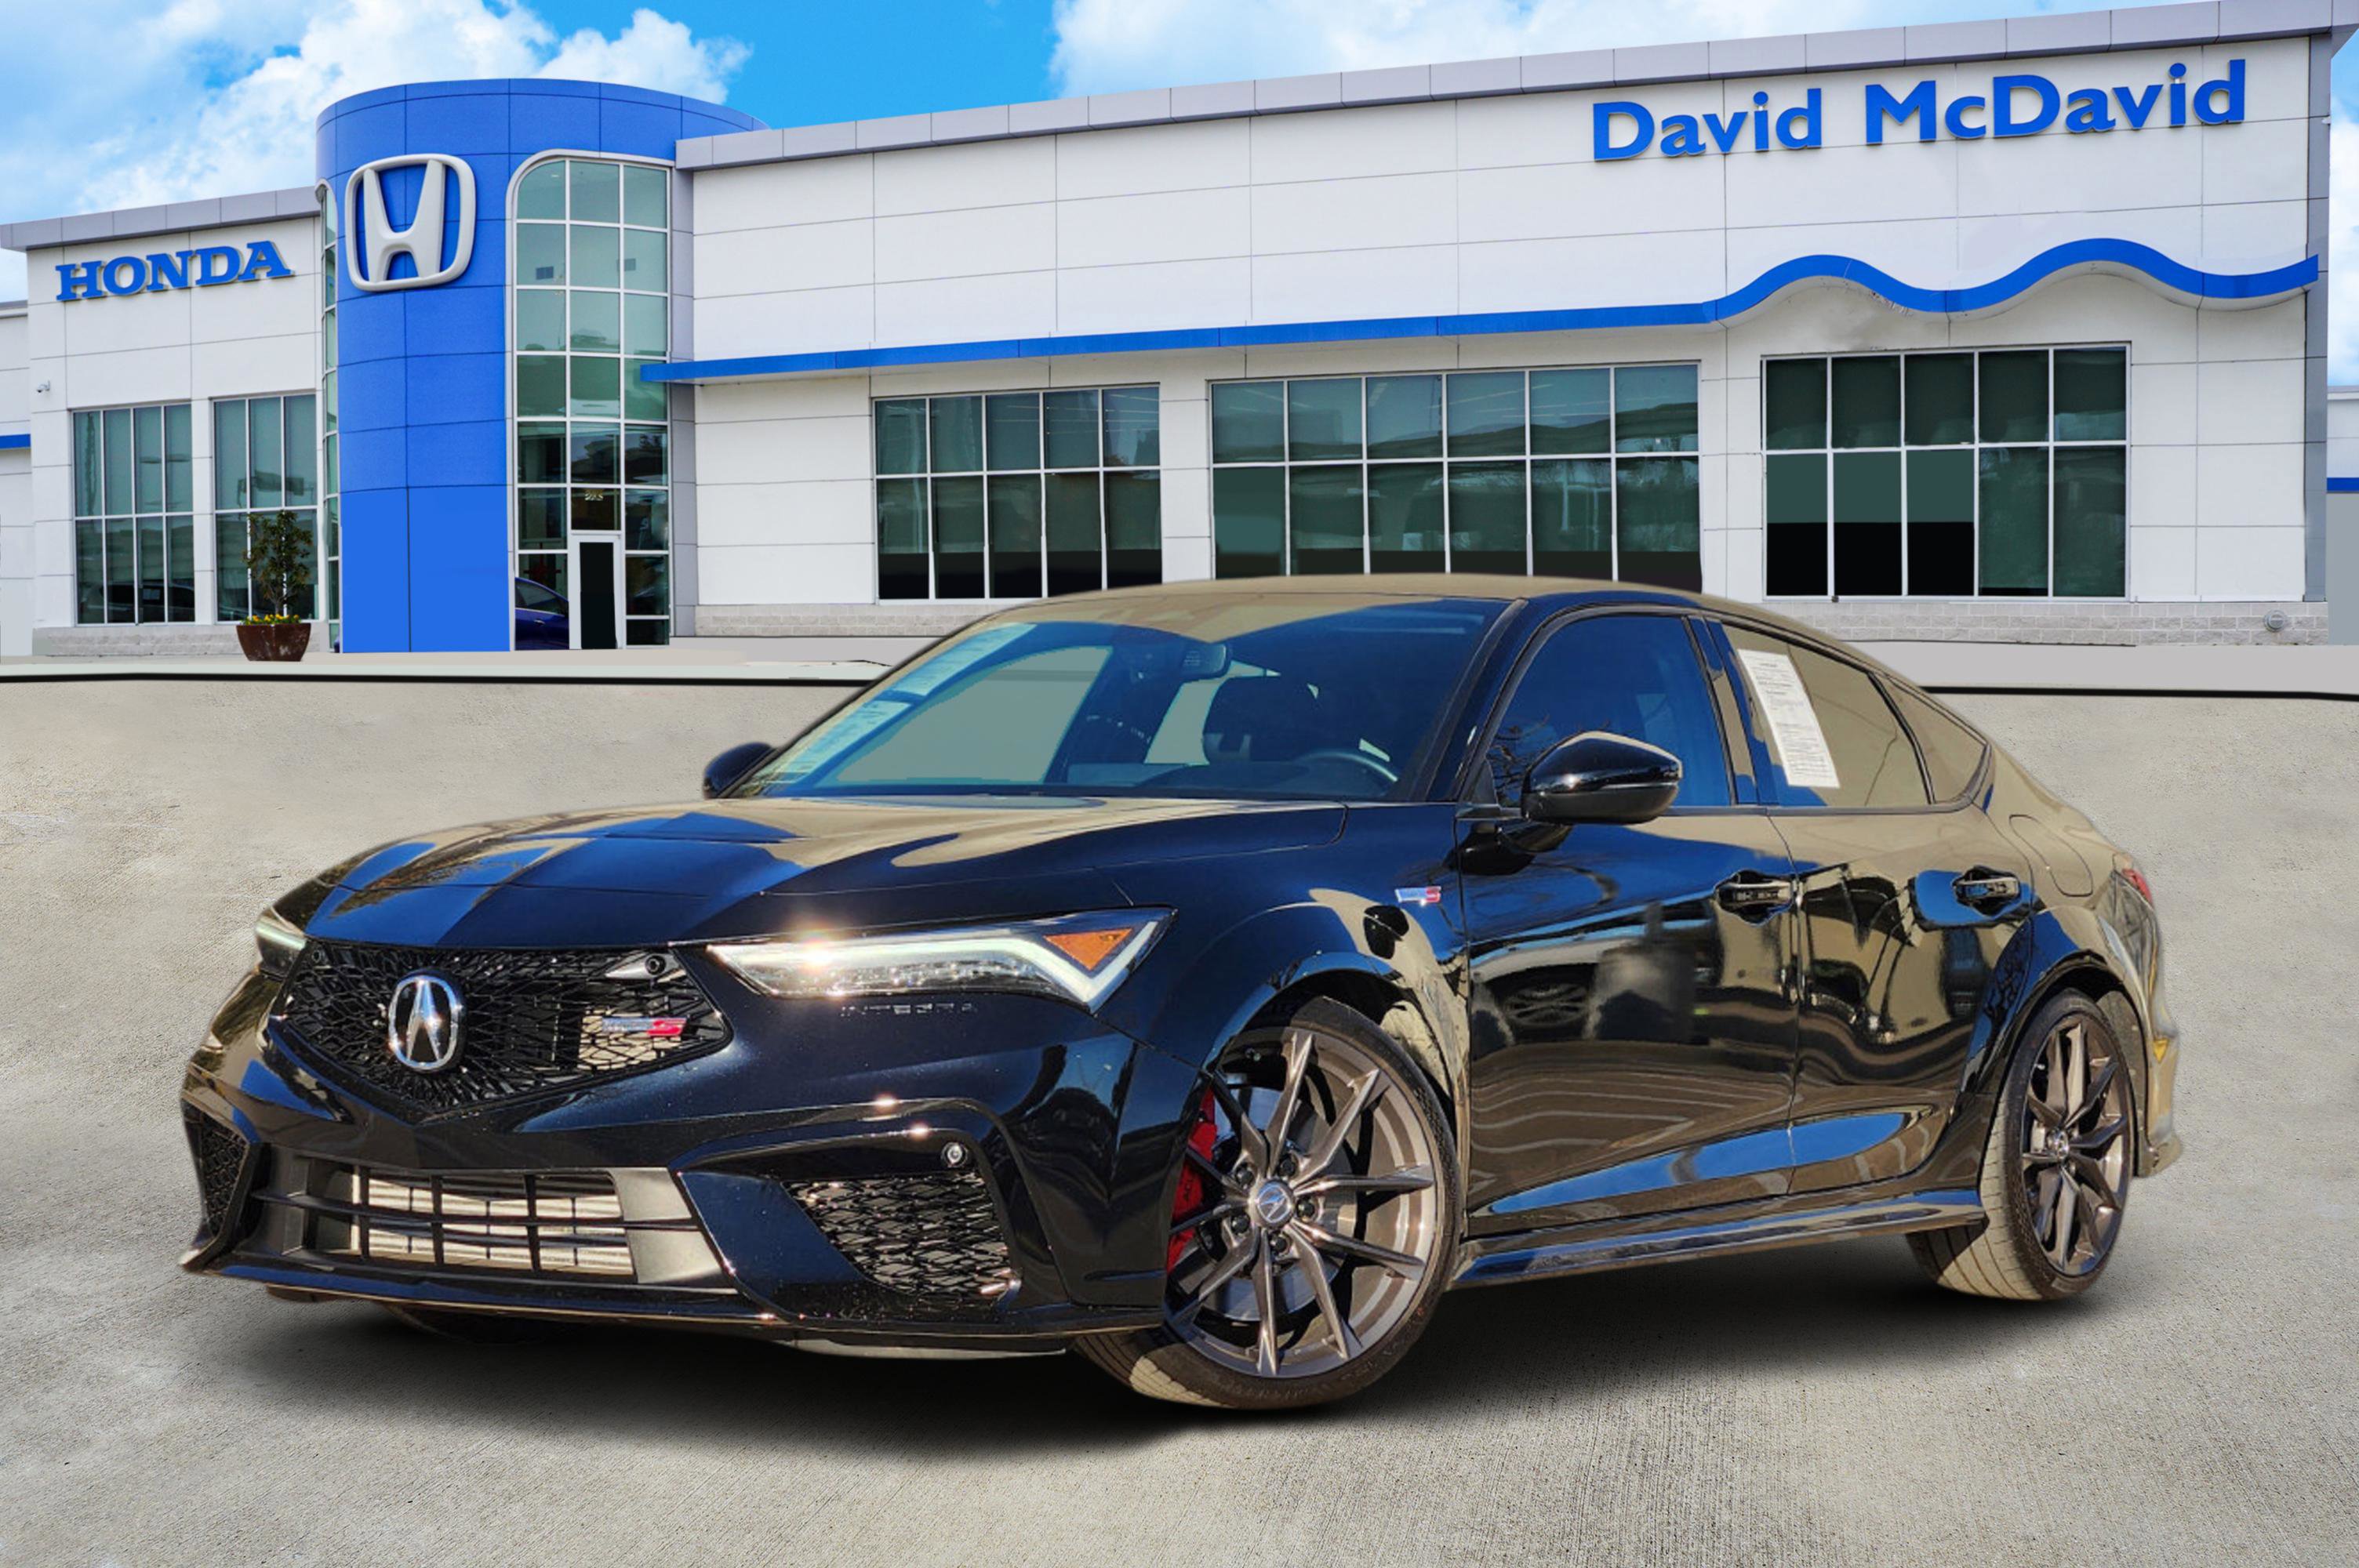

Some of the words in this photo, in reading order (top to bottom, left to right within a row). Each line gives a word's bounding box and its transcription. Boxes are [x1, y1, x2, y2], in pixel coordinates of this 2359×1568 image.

[1594, 88, 1822, 162] David
[1865, 59, 2247, 144] McDavid
[55, 240, 295, 302] HONDA
